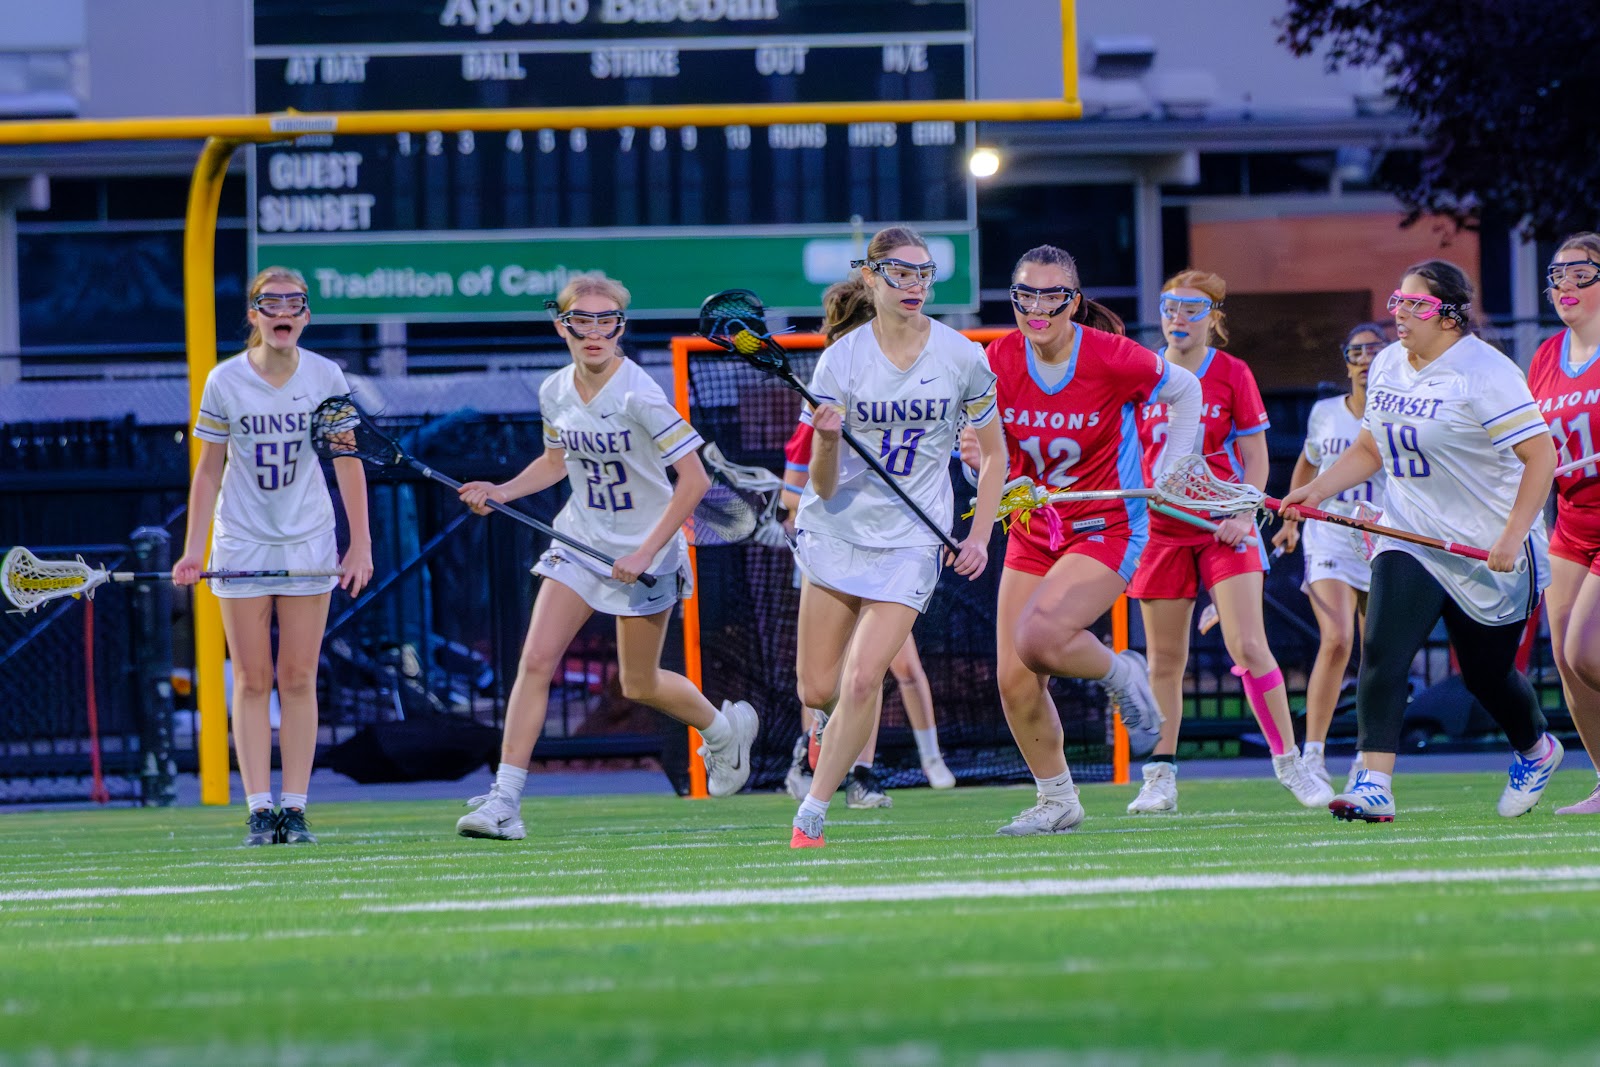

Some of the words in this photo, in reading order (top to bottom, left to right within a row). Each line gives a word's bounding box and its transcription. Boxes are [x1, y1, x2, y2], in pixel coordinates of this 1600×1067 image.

[440, 0, 588, 33] Apollo
[600, 0, 779, 23] Baseball
[285, 52, 318, 84] AT
[320, 52, 369, 84] BAT
[462, 50, 527, 80] BALL
[590, 48, 680, 78] STRIKE
[755, 44, 809, 75] OUT
[426, 131, 443, 156] 2
[458, 130, 475, 155] 3
[506, 129, 523, 154] 4
[617, 126, 635, 152] 7
[269, 152, 362, 189] GUEST
[258, 193, 376, 232] SUNSET
[314, 266, 454, 299] Tradition
[457, 265, 494, 296] of
[499, 264, 606, 297] Cari
[856, 398, 951, 423] SUNSET
[1003, 407, 1100, 430] SAXONS
[1142, 404, 1222, 420] SANS
[1372, 390, 1444, 419] SUNSET
[876, 427, 926, 477] 18
[1382, 422, 1431, 478] 19
[1549, 411, 1598, 478] 11
[255, 440, 303, 491] 55
[1018, 435, 1082, 488] 12
[578, 458, 634, 512] 22
